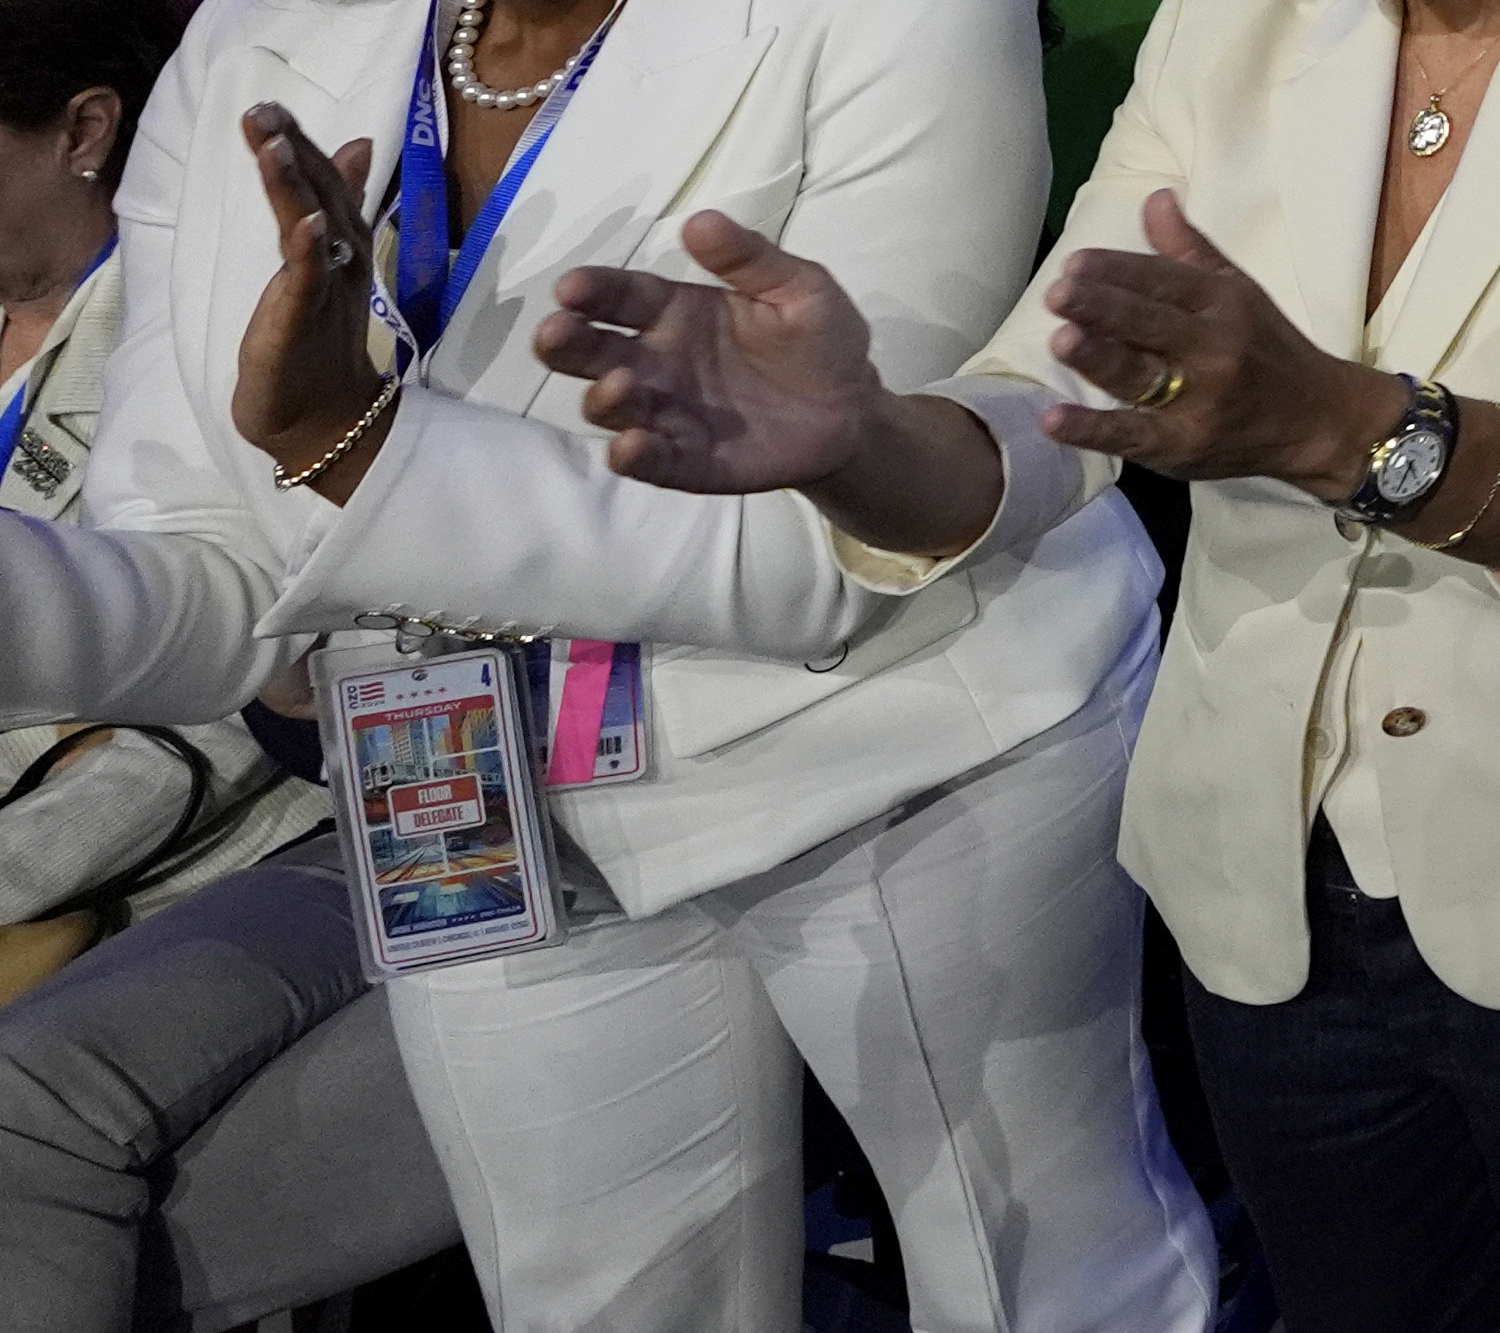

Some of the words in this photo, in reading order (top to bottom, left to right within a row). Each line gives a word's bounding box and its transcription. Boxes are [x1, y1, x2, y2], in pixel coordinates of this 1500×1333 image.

[481, 663, 491, 687] 4
[384, 702, 461, 722] THURSDAY
[413, 805, 464, 829] DELEGATE
